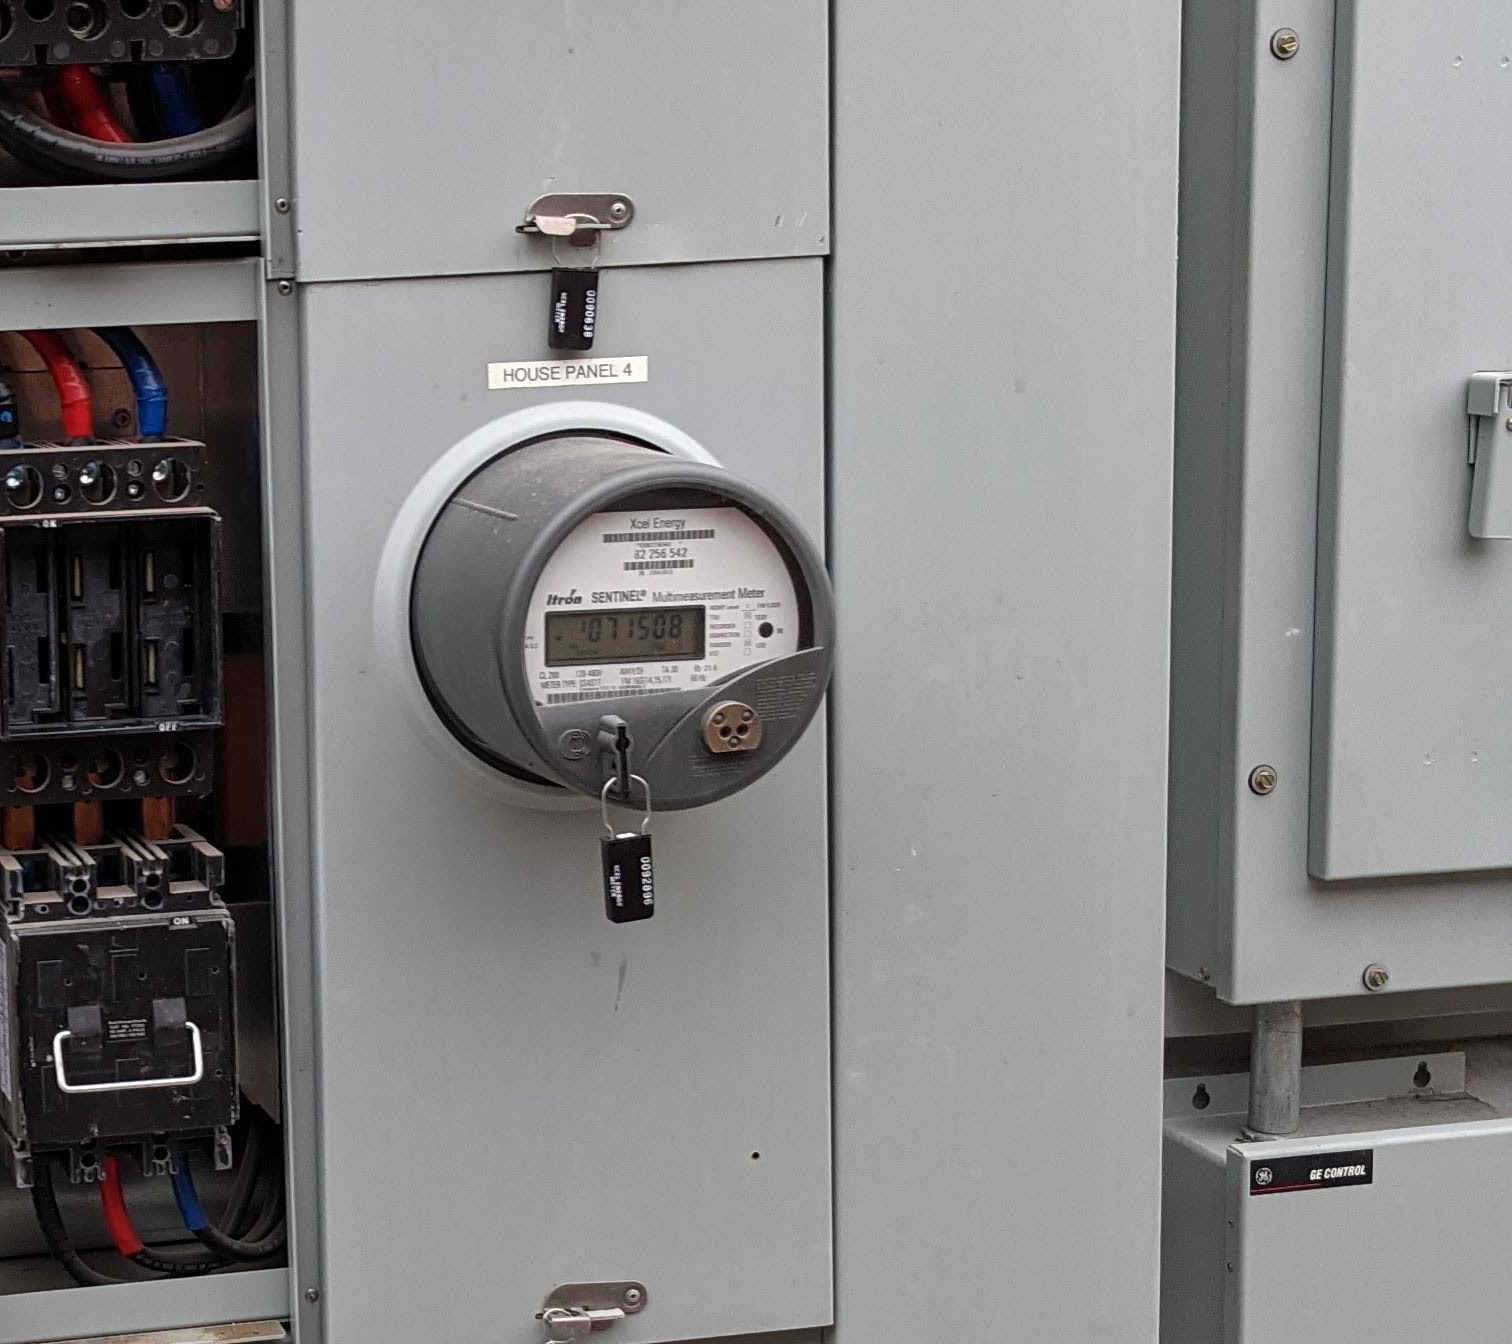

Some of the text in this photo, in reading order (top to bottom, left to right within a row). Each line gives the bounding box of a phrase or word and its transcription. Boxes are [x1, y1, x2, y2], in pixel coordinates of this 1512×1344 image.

[503, 363, 633, 382] HOUSE PANEL 4
[629, 518, 686, 530] Xcel Energy
[648, 548, 667, 559] 256
[669, 547, 687, 558] 542
[546, 588, 582, 606] Itron
[652, 590, 736, 603] Multimeasurement
[738, 587, 765, 599] Meter
[1309, 1164, 1366, 1181] GE CONTROL
